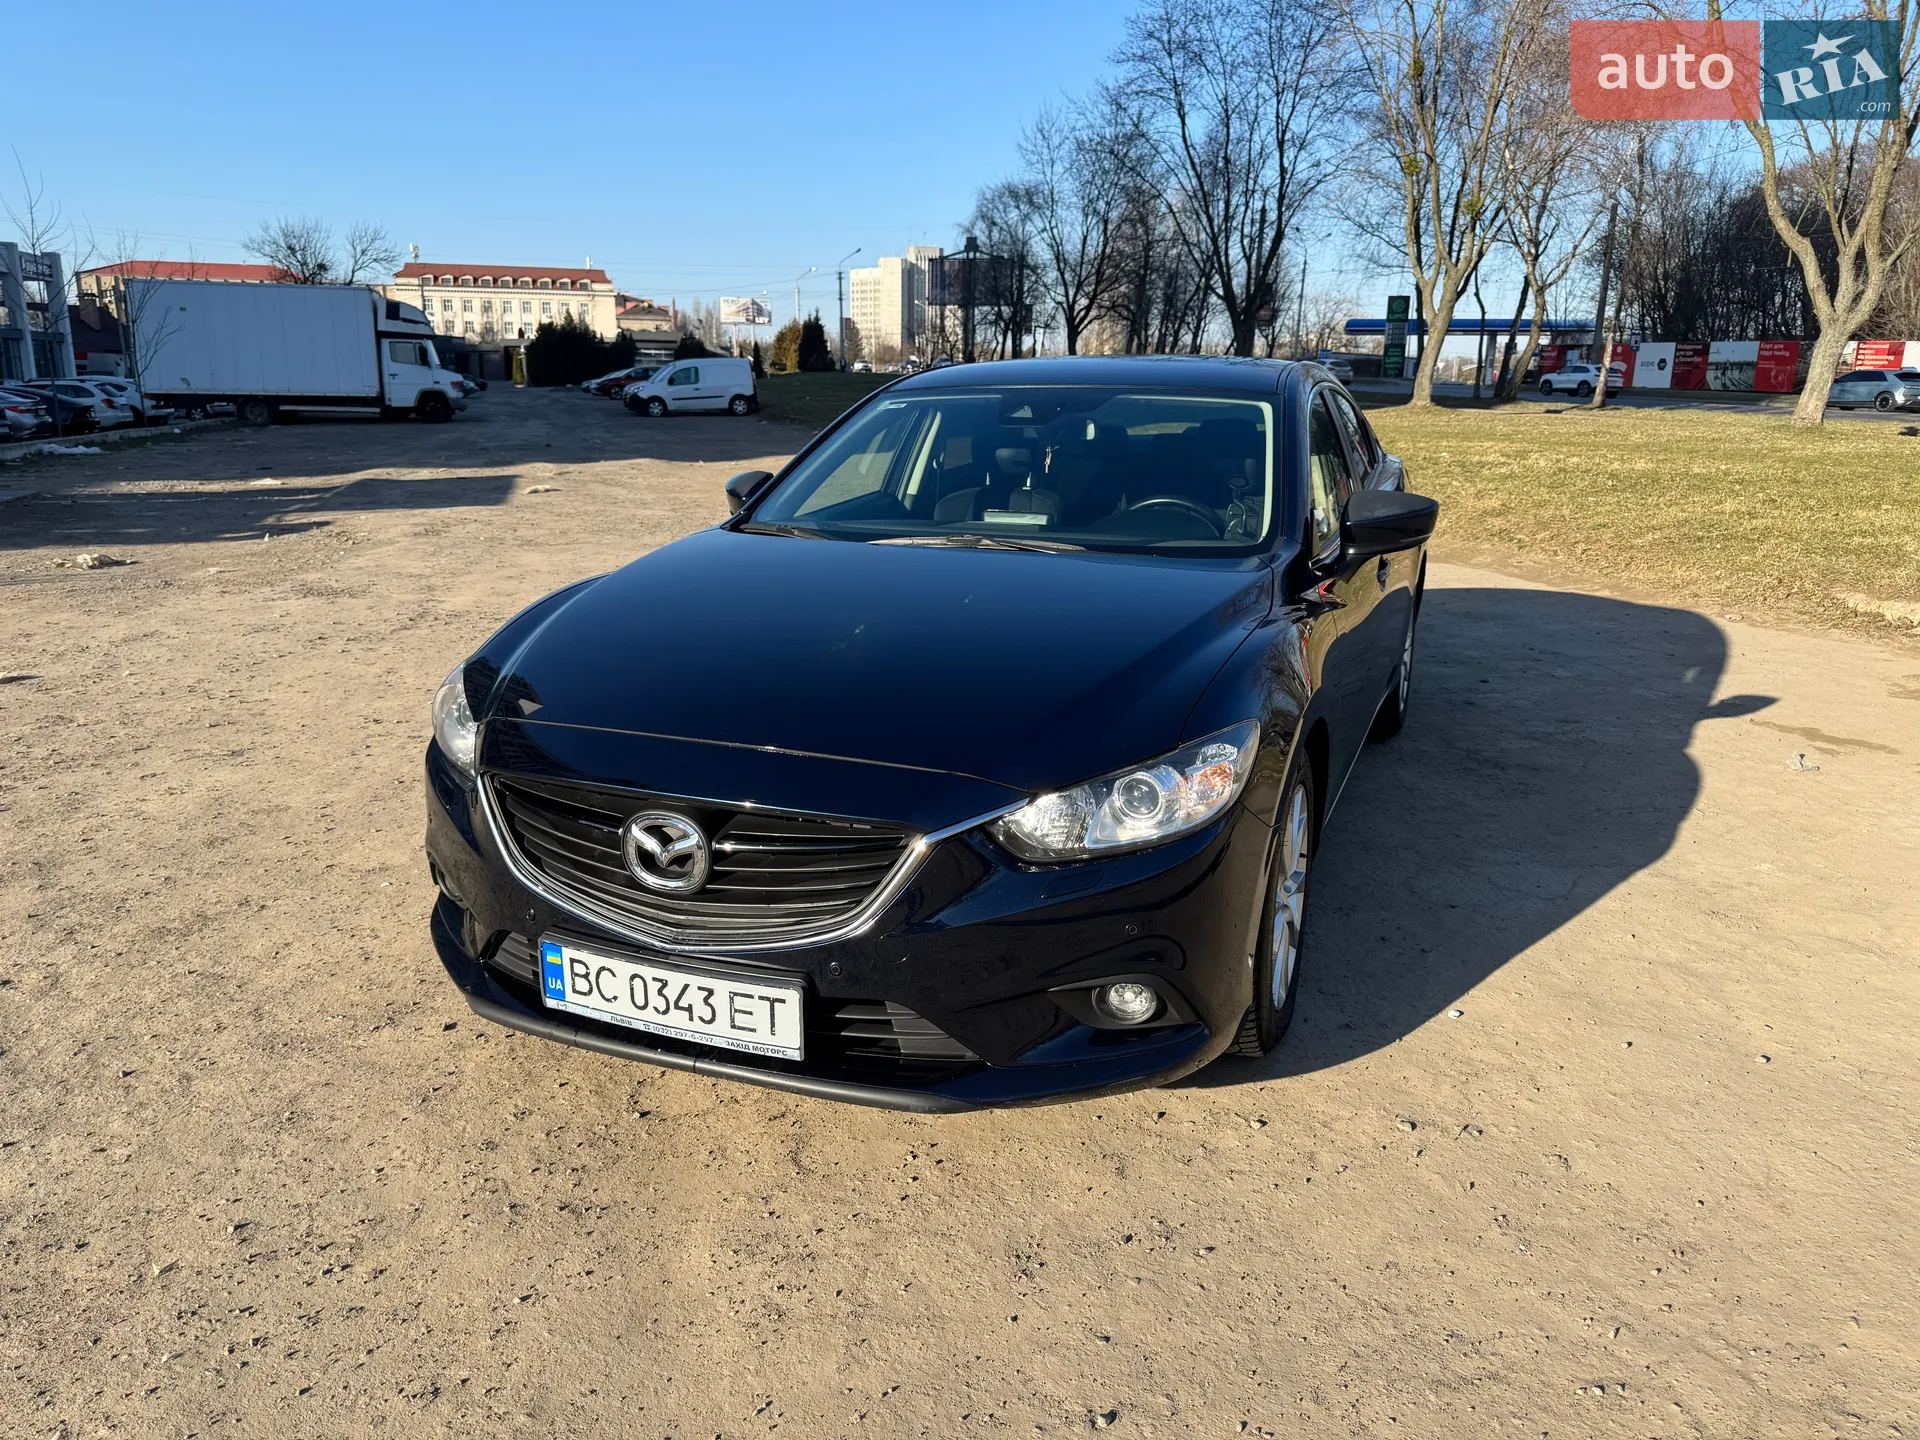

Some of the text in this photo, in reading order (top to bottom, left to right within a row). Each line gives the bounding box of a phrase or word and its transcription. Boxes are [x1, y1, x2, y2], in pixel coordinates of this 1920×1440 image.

[548, 976, 564, 991] UA
[569, 957, 786, 1036] BC 0343 ET
[610, 1015, 633, 1026] ЛЬВІВ
[725, 1040, 788, 1057] ЗАХІД МОТОРС
